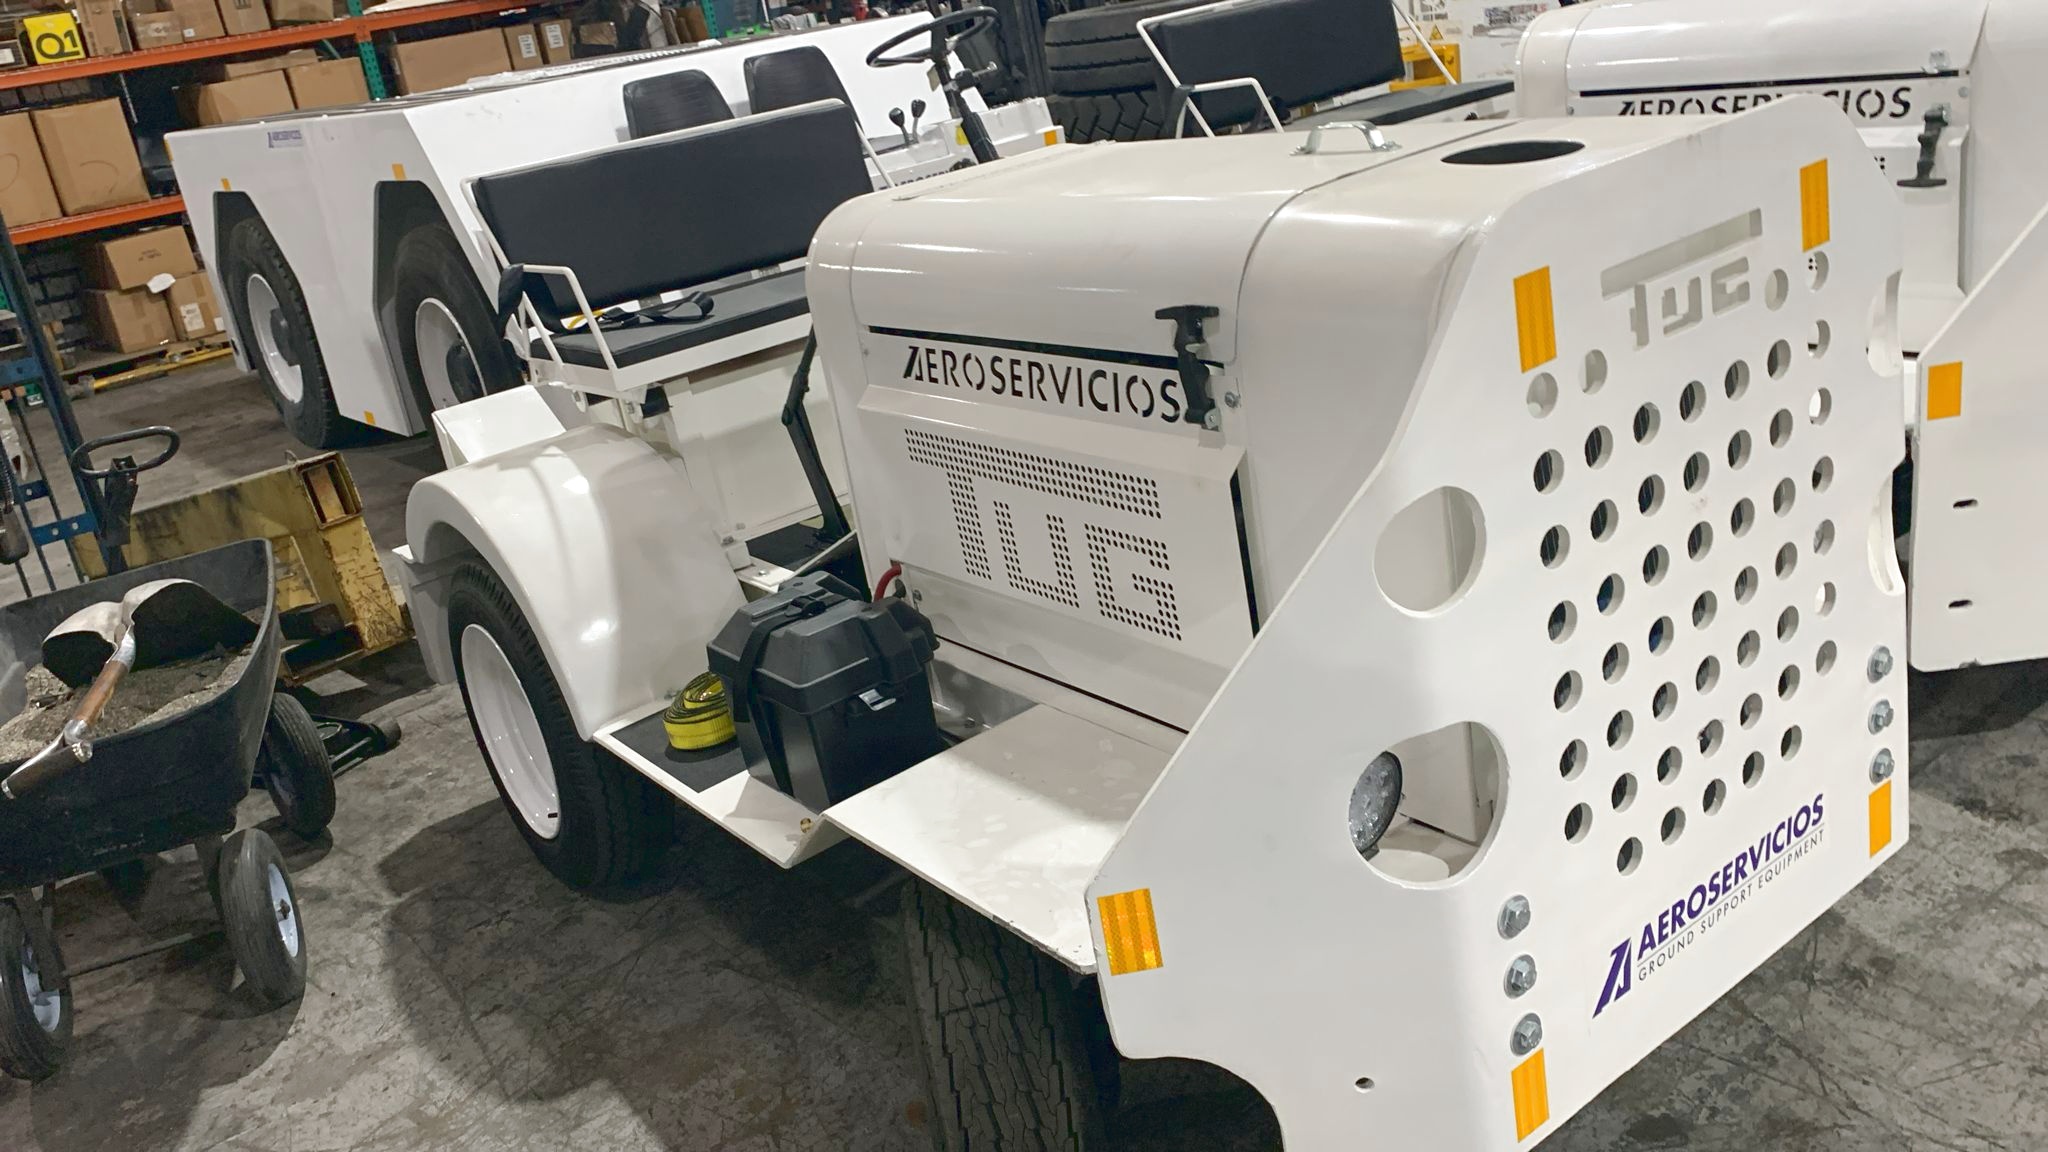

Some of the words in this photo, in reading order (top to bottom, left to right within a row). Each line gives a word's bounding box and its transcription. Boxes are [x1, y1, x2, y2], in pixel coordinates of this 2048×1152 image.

[903, 345, 1181, 423] AEROSERVICIOS
[904, 428, 1182, 641] TUG
[1637, 793, 1824, 961] AEROSERVICIOS
[1638, 930, 1694, 981] GROUND
[1700, 885, 1753, 934] SUPPORT
[1758, 829, 1825, 889] EQUIPMENT
